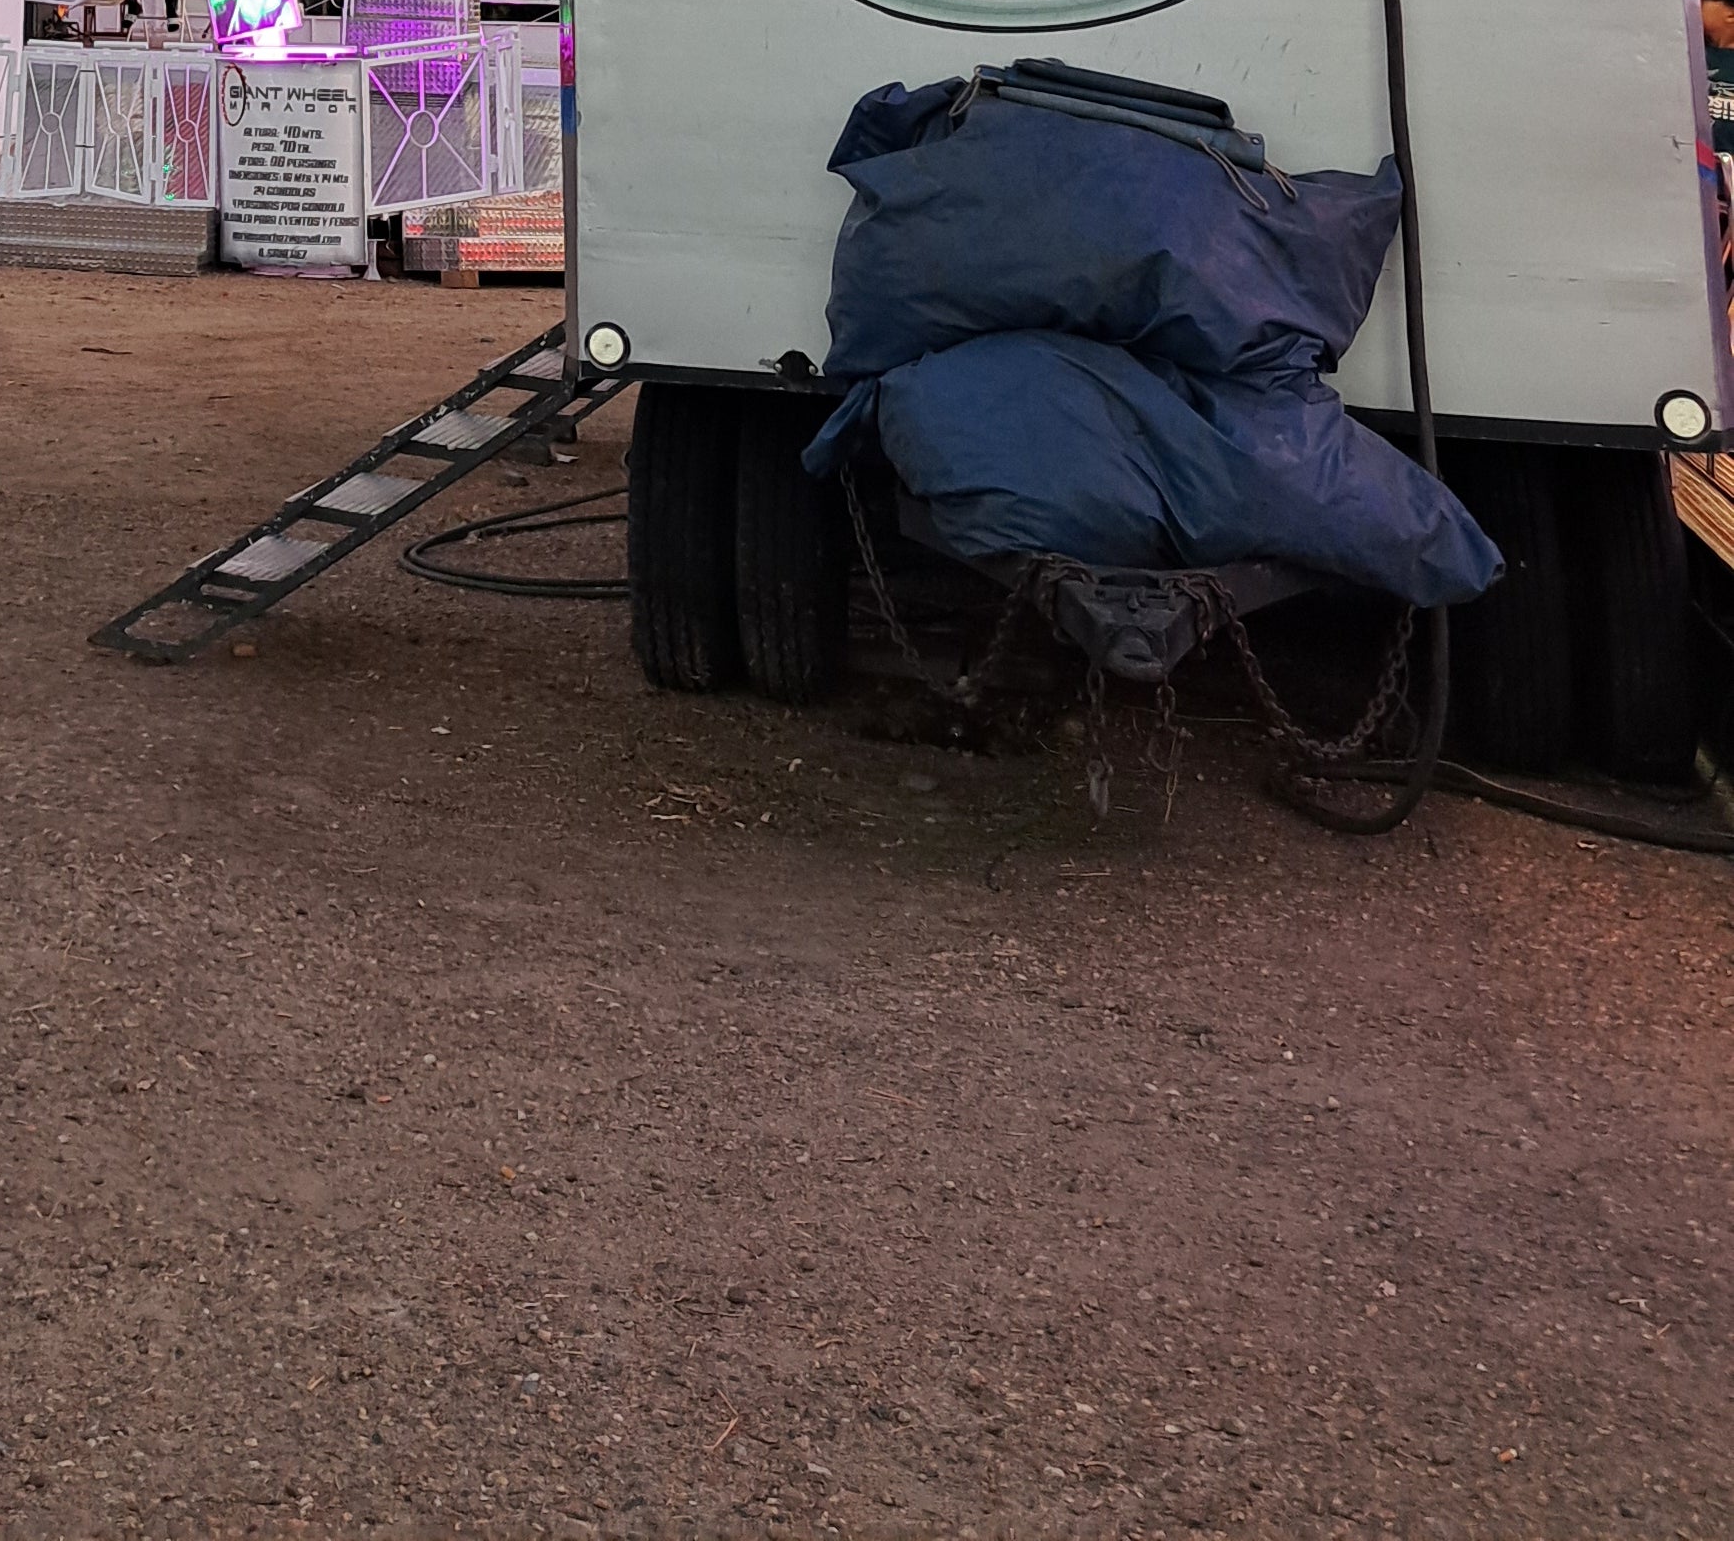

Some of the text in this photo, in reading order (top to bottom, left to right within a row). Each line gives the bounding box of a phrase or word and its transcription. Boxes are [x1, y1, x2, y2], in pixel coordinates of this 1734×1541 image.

[229, 85, 357, 102] GIANT WHEEL
[229, 101, 357, 114] MIRADOR
